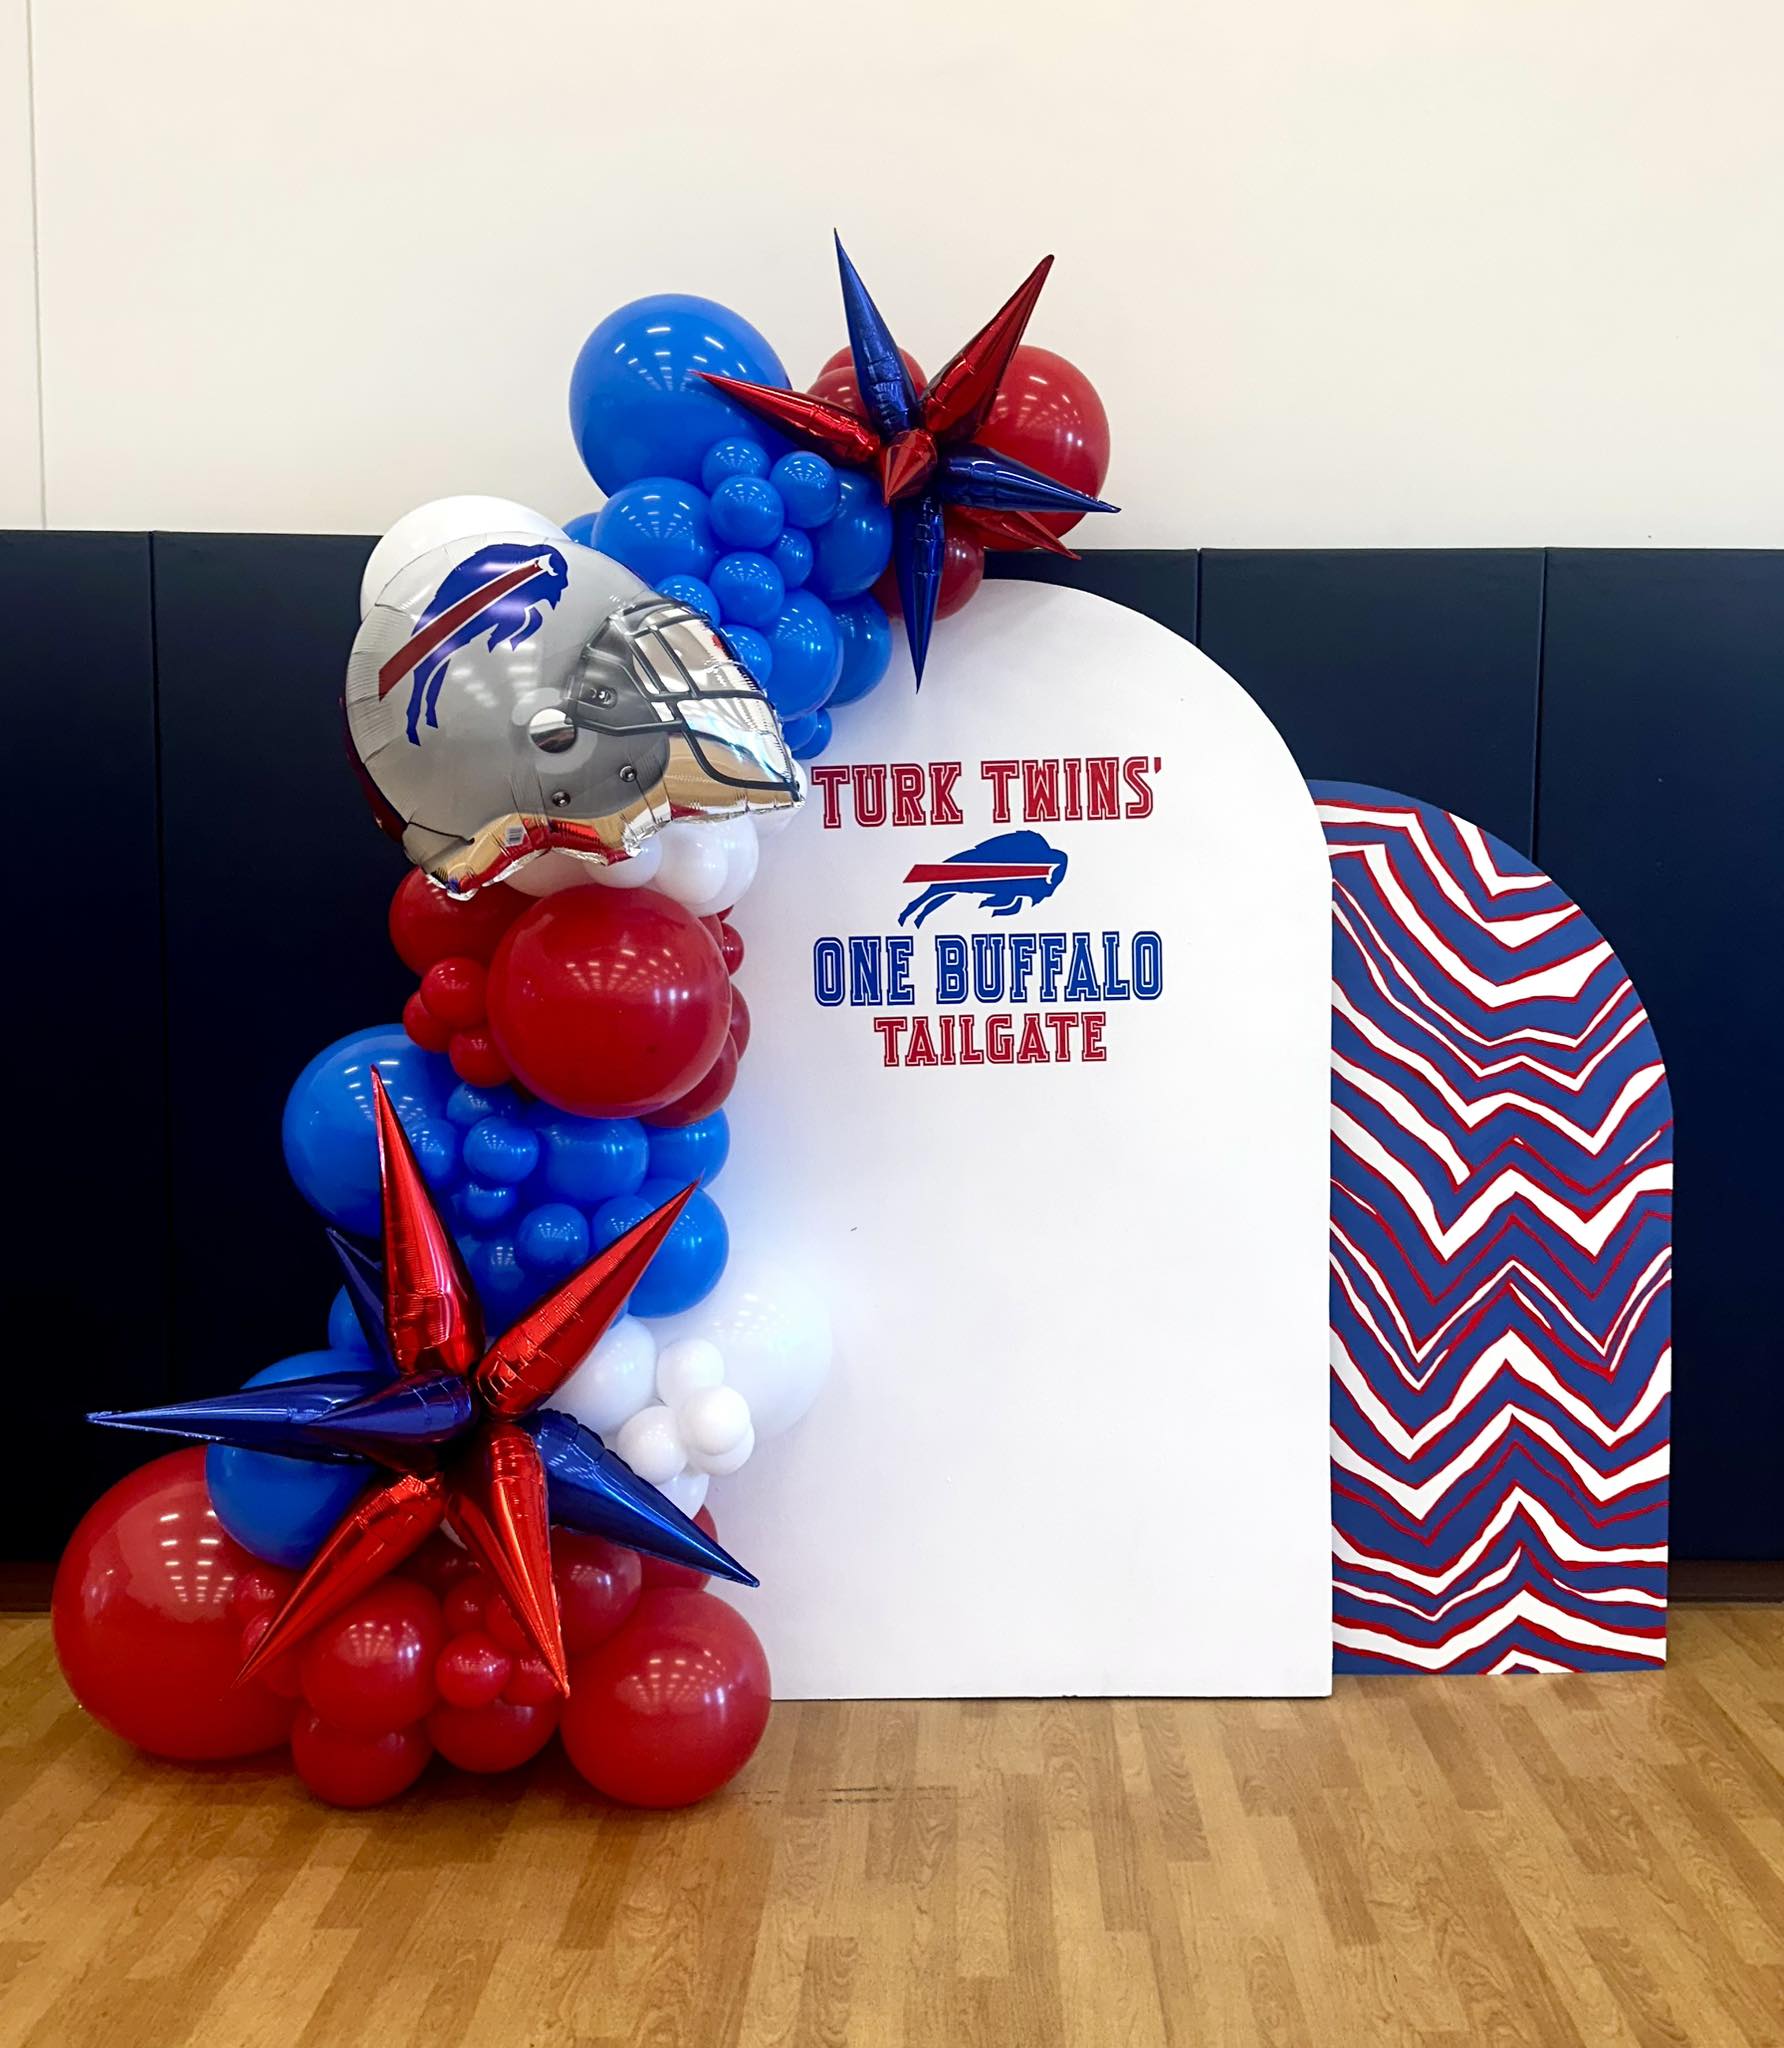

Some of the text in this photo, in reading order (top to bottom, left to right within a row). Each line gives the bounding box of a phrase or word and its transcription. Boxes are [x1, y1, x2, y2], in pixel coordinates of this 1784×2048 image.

[811, 756, 1161, 829] TURK TWINS'
[814, 931, 1163, 1006] ONE BUFFALO
[874, 1011, 1107, 1067] TAILGATE
